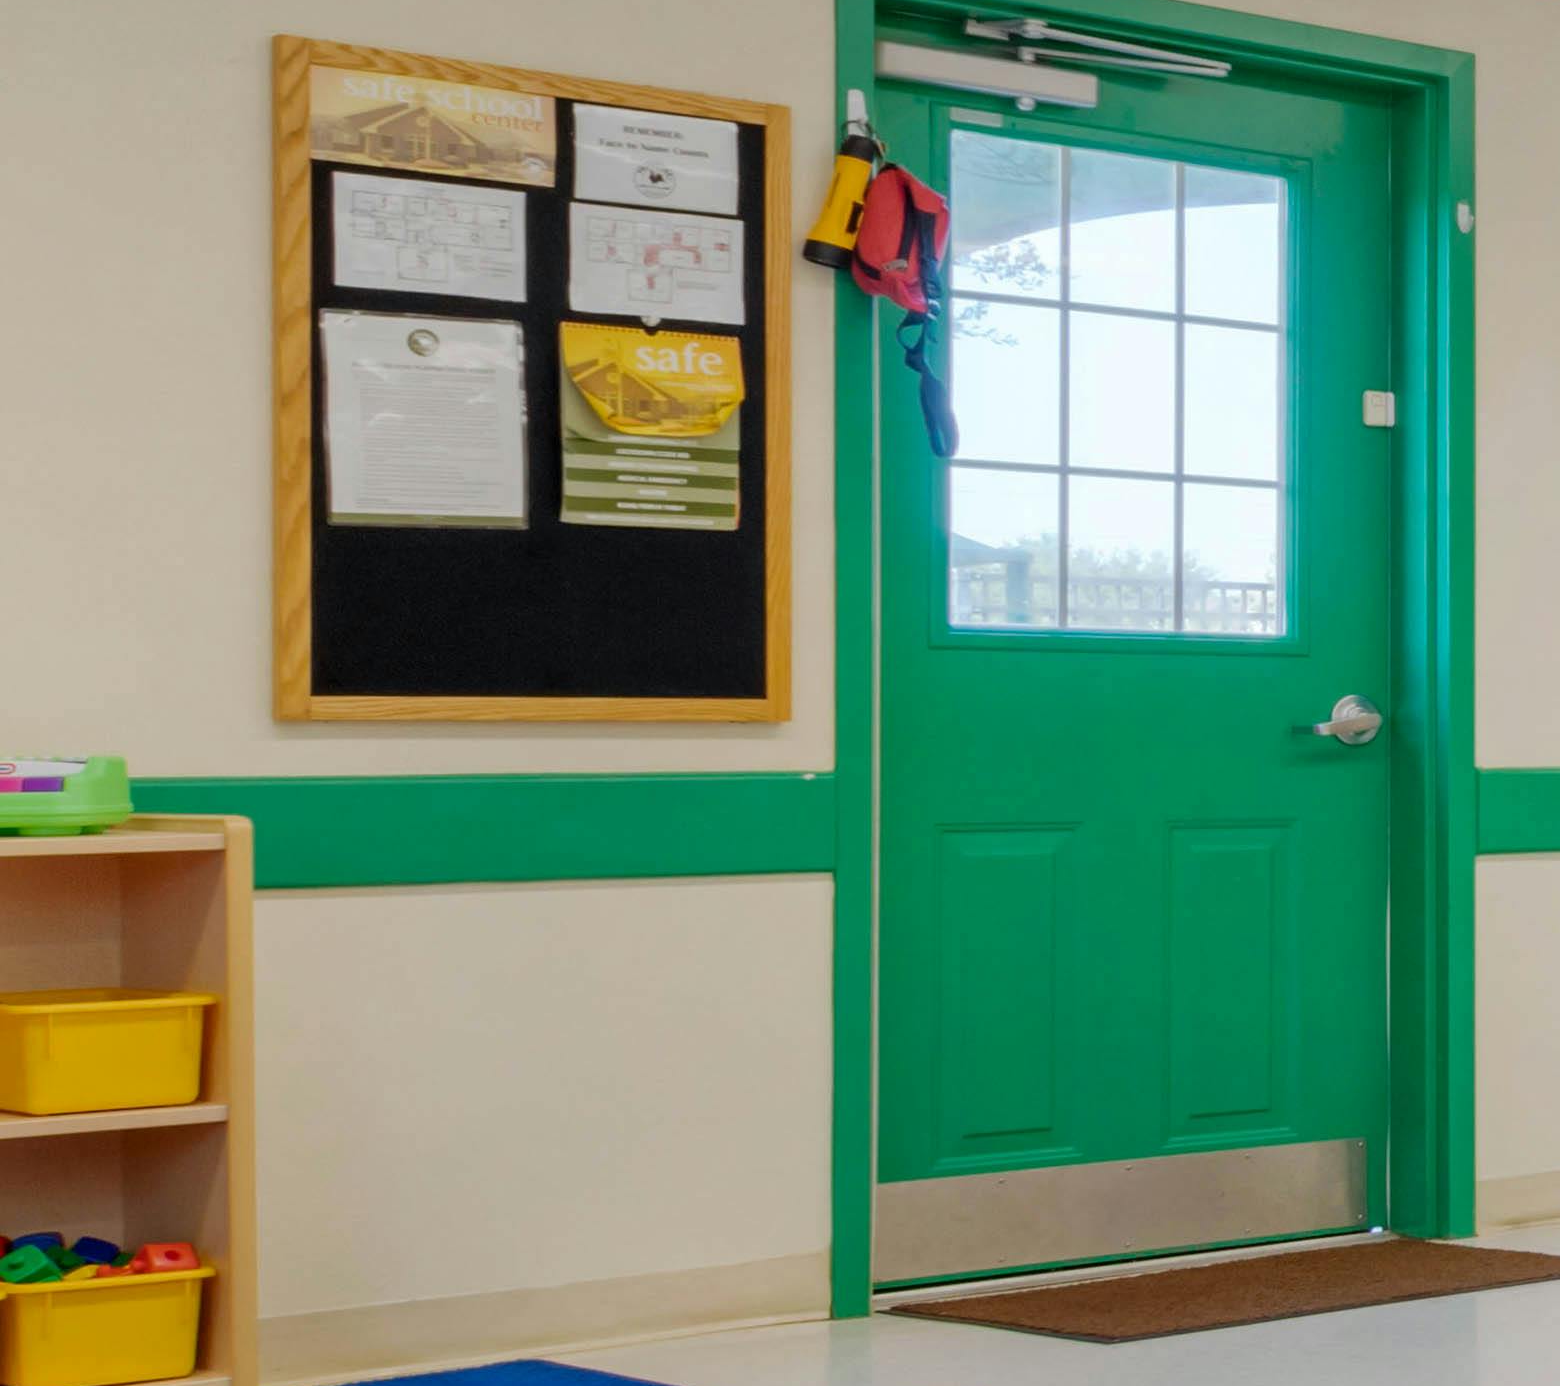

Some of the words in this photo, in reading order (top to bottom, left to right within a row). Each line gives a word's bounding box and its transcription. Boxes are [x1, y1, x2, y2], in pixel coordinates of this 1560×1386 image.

[343, 74, 417, 103] safe
[426, 87, 544, 121] school
[471, 114, 544, 134] center
[635, 341, 723, 376] safe
